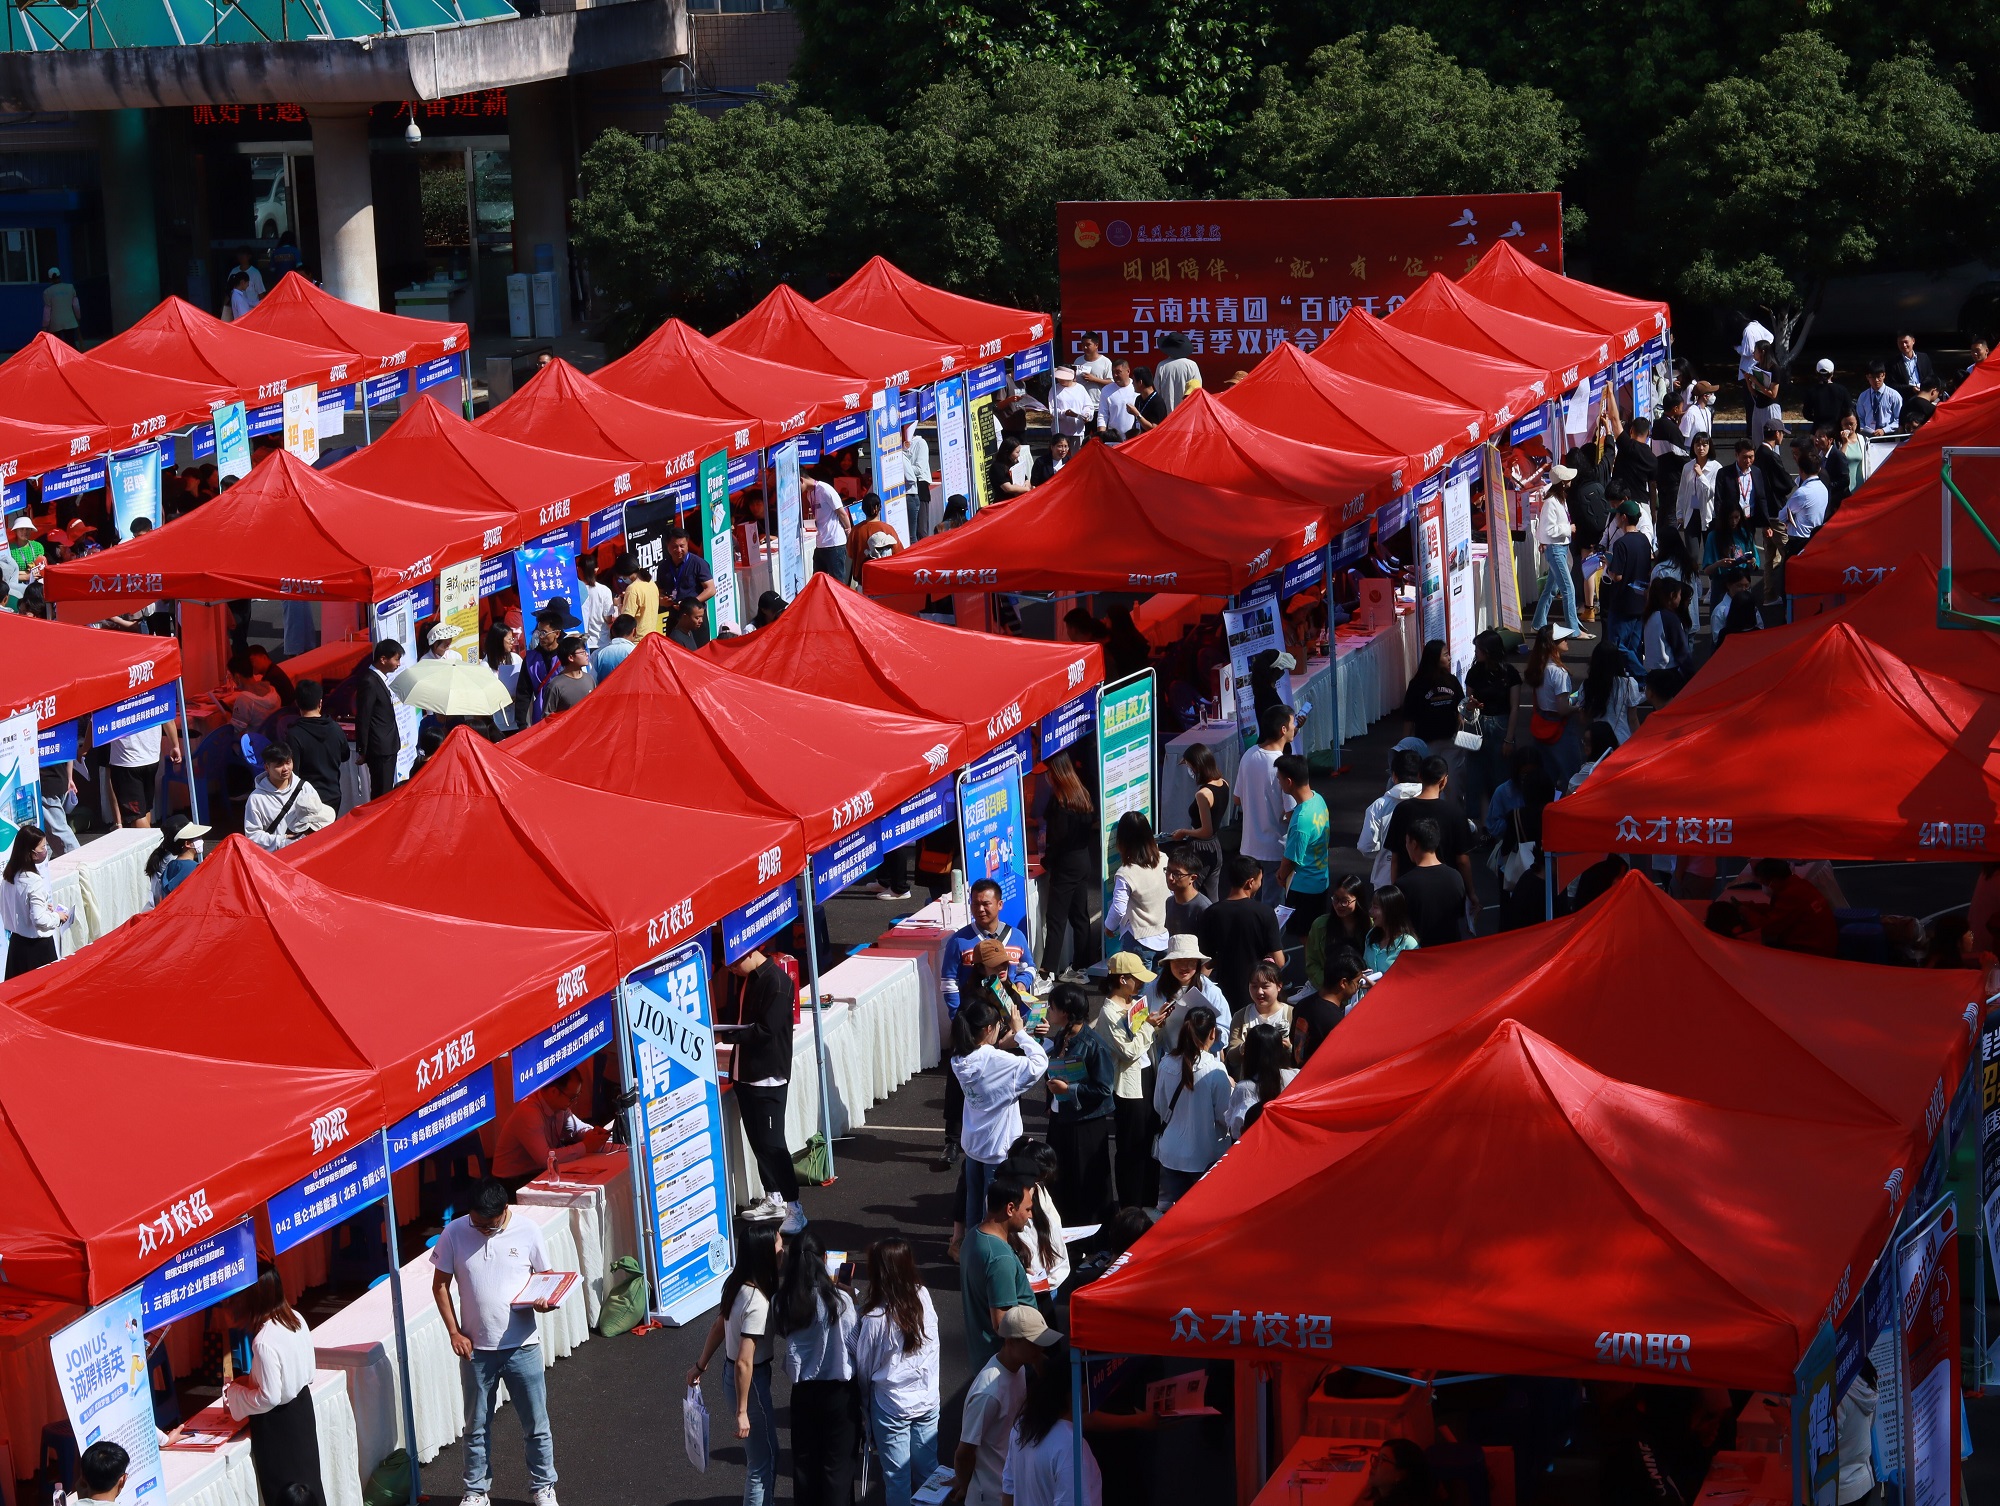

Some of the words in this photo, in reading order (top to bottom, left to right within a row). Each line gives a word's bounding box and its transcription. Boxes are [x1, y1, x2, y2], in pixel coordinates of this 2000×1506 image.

[1137, 224, 1221, 238] 昆明文理学院
[442, 336, 458, 352] 纳职
[979, 338, 1001, 358] 众才校招
[330, 363, 348, 382] 纳职
[380, 350, 407, 368] 众才校招
[258, 379, 288, 400] 众才校招
[885, 370, 909, 389] 众才校招
[131, 415, 167, 438] 众才校招
[781, 411, 806, 433] 众才校招
[70, 435, 91, 457] 纳职
[287, 423, 316, 453] 招聘
[734, 428, 750, 450] 纳职
[665, 450, 695, 478] 众才校招
[1423, 444, 1444, 472] 众才校招
[45, 482, 54, 493] 144
[122, 473, 149, 494] 招聘
[613, 472, 632, 497] 纳职
[539, 498, 570, 526] 众才校招
[1342, 492, 1365, 522] 众才校招
[483, 525, 503, 550] 纳职
[635, 538, 664, 570] 招聘
[88, 573, 163, 594] 众才校招
[279, 577, 324, 595] 纳职
[913, 568, 998, 586] 众才校招
[1128, 570, 1178, 587] 纳职
[1842, 565, 1897, 585] 众才
[128, 660, 154, 688] 纳职
[1068, 662, 1086, 690] 纳职
[987, 702, 1021, 740] 众才校招
[1103, 690, 1151, 731] 招募英才
[97, 724, 109, 735] 094
[38, 742, 61, 757] 有限公司
[831, 790, 874, 832] 众才校招
[966, 788, 1008, 830] 校园招聘
[881, 829, 893, 842] 048
[1616, 814, 1733, 845] 众才校招
[1918, 821, 1986, 851] 纳职
[758, 846, 782, 884] 纳职
[818, 872, 829, 885] 047
[648, 898, 694, 948] 众才校招
[729, 937, 741, 949] 046
[556, 964, 588, 1008] 纳职
[666, 961, 702, 1022] 招
[633, 998, 679, 1046] JION
[680, 1026, 705, 1062] US
[416, 1030, 475, 1092] 众才校招
[519, 1068, 534, 1084] 044
[535, 1020, 605, 1075] 瑞丽市华泽进出口有限公司
[637, 1040, 672, 1101] 聘
[310, 1107, 349, 1155] 纳职
[393, 1139, 409, 1154] 043
[410, 1093, 487, 1146] 青岛乾程科技股份有限公司
[275, 1217, 291, 1235] 042
[293, 1164, 387, 1227] 昆仑北能能源（北京）有限公司
[138, 1187, 213, 1259] 众才校招
[153, 1256, 245, 1312] 云南筑才企业管理有限公司
[1169, 1306, 1333, 1349] 众才校招
[1594, 1330, 1693, 1372] 纳职
[69, 1345, 126, 1405] 诚聘精英
